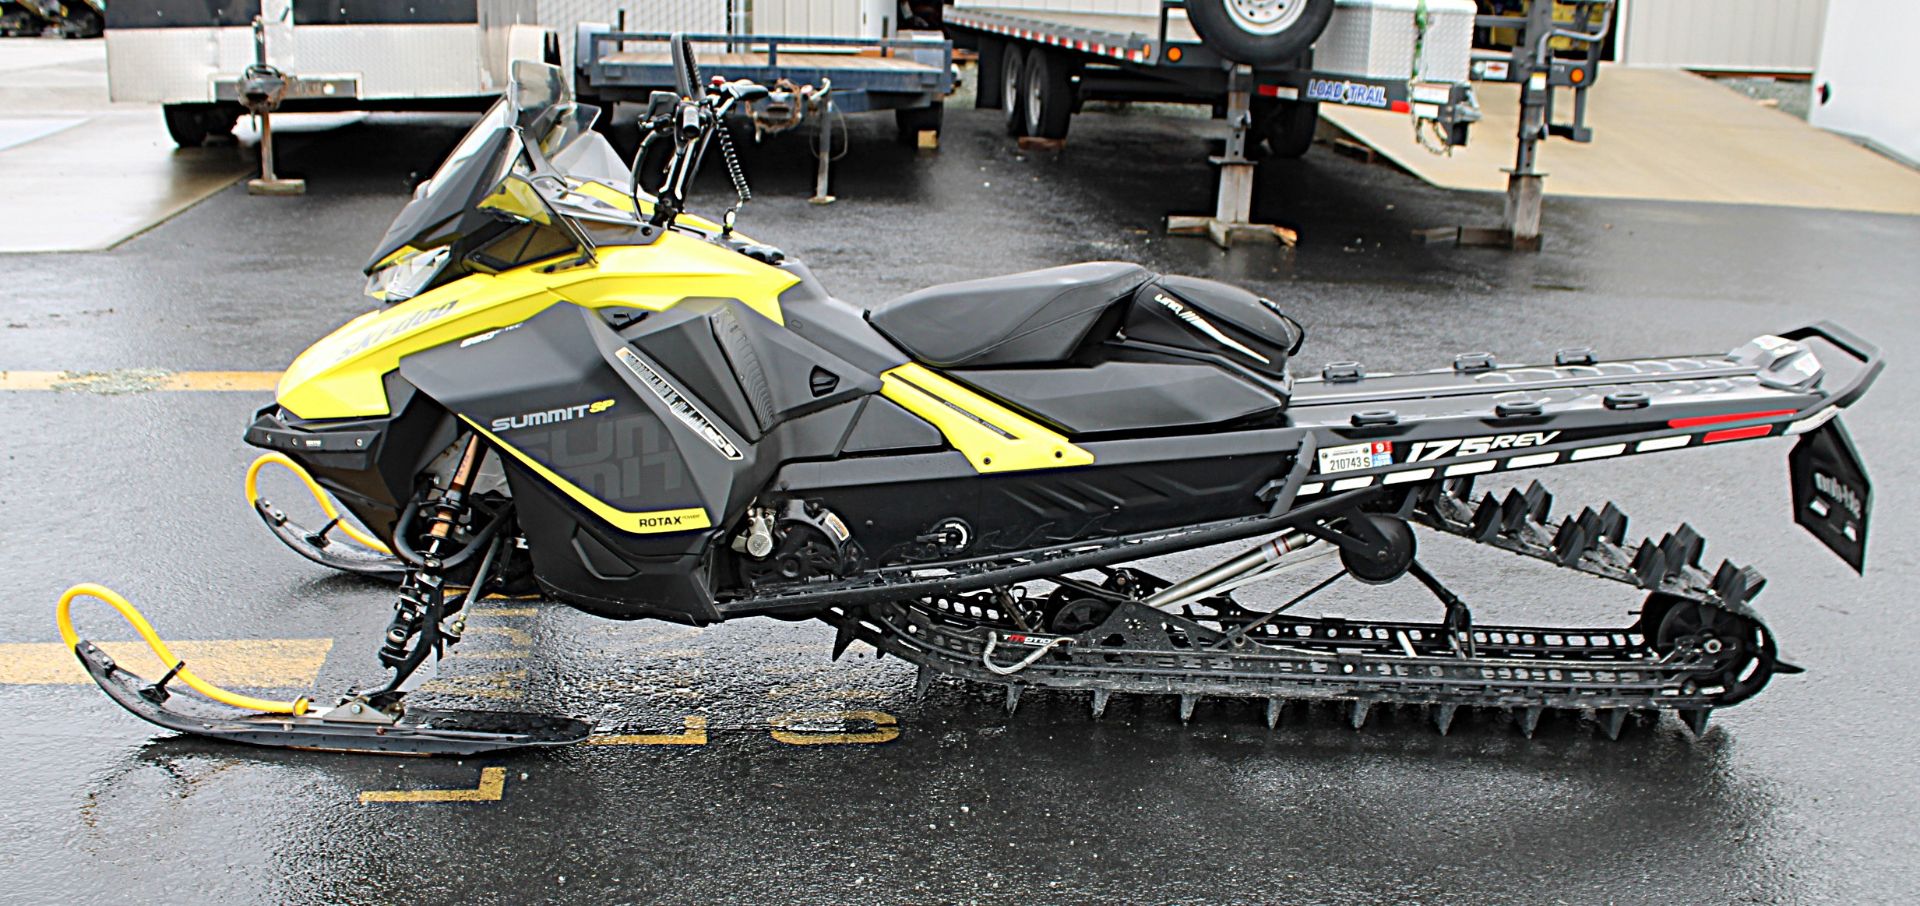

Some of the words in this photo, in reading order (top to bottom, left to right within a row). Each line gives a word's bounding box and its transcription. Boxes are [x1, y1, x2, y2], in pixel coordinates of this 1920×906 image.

[1307, 79, 1344, 101] LOAD
[1348, 85, 1387, 106] TRAIL
[491, 403, 590, 432] SUMMIT
[1330, 457, 1362, 471] 210743
[639, 515, 682, 528] ROTAX
